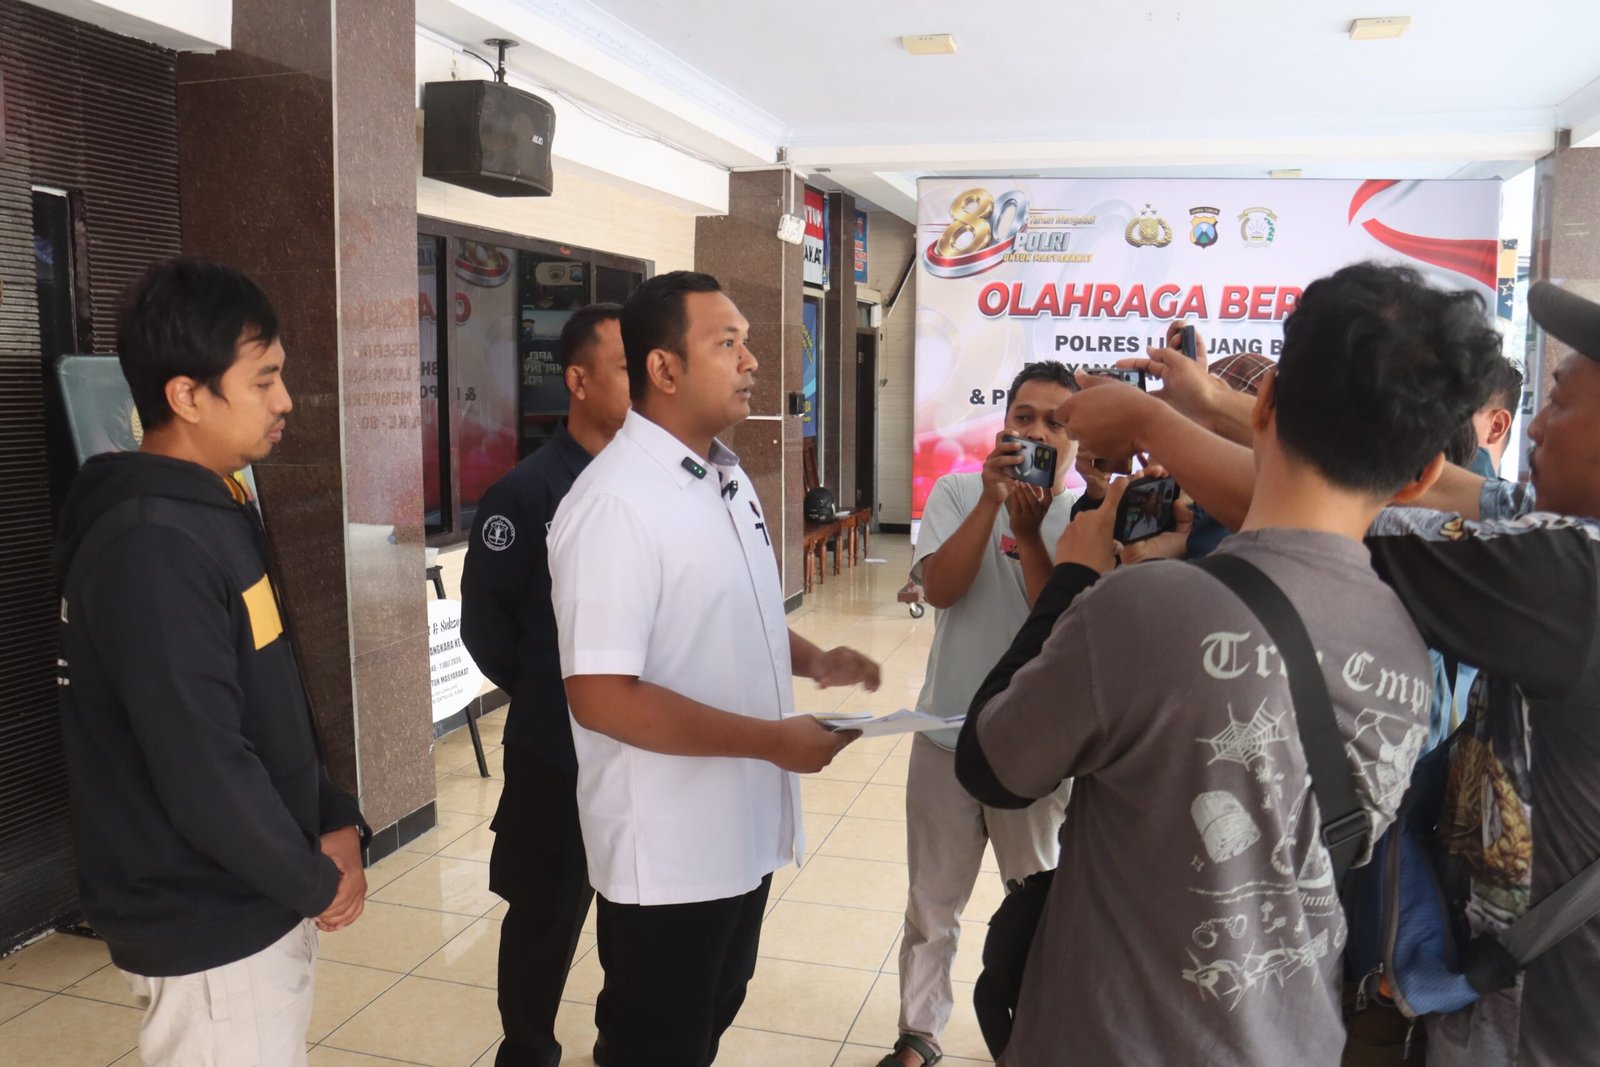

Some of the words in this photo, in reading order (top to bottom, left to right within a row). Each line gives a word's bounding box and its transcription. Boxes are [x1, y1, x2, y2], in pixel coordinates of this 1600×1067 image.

[937, 187, 1030, 257] 80
[1013, 232, 1070, 252] POLRI
[977, 281, 1208, 319] OLAHRAGA
[1055, 335, 1140, 352] POLRES
